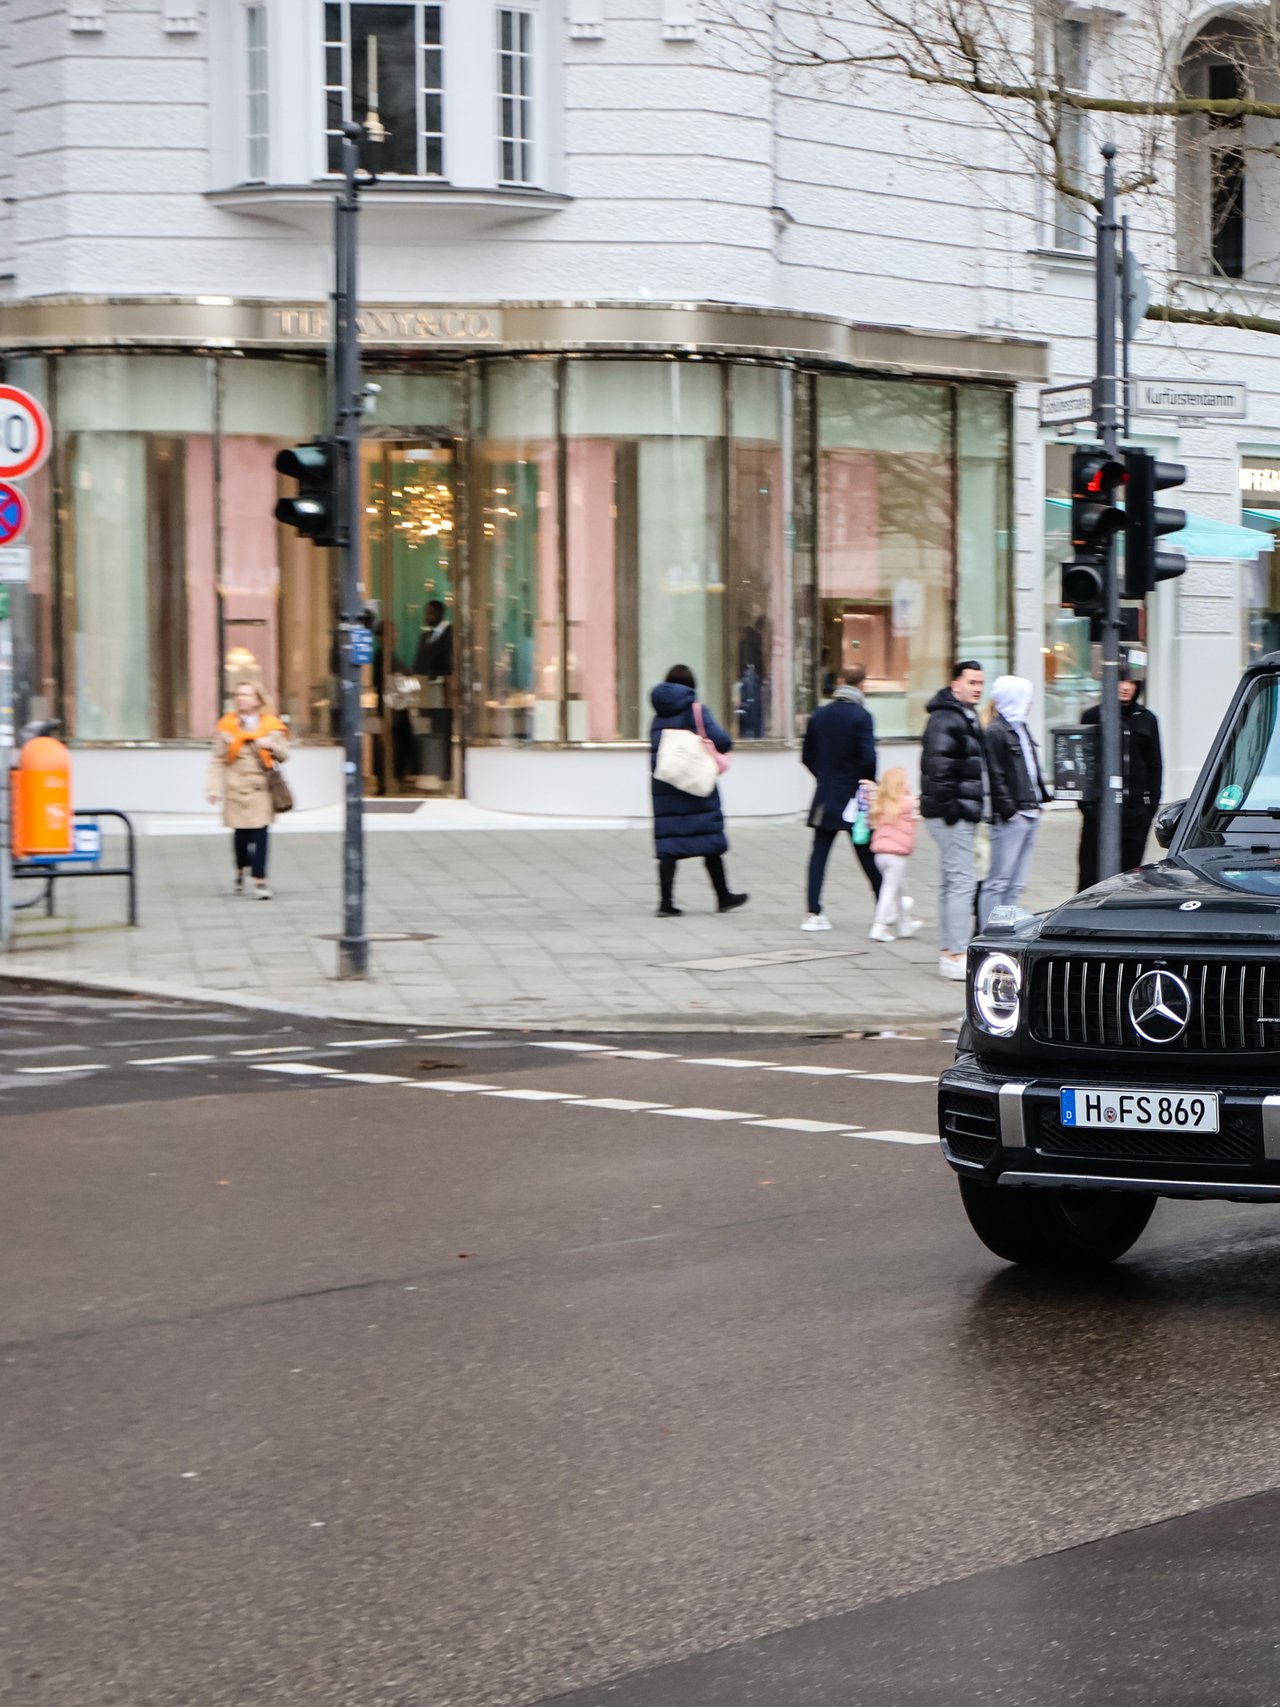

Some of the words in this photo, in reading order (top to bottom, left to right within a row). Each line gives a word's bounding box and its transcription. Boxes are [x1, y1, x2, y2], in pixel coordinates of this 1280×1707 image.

[272, 310, 495, 338] TIFANY&CO.
[1066, 1110, 1073, 1119] D
[1085, 1094, 1102, 1122] H
[1119, 1095, 1152, 1124] FS
[1158, 1097, 1206, 1127] 869
